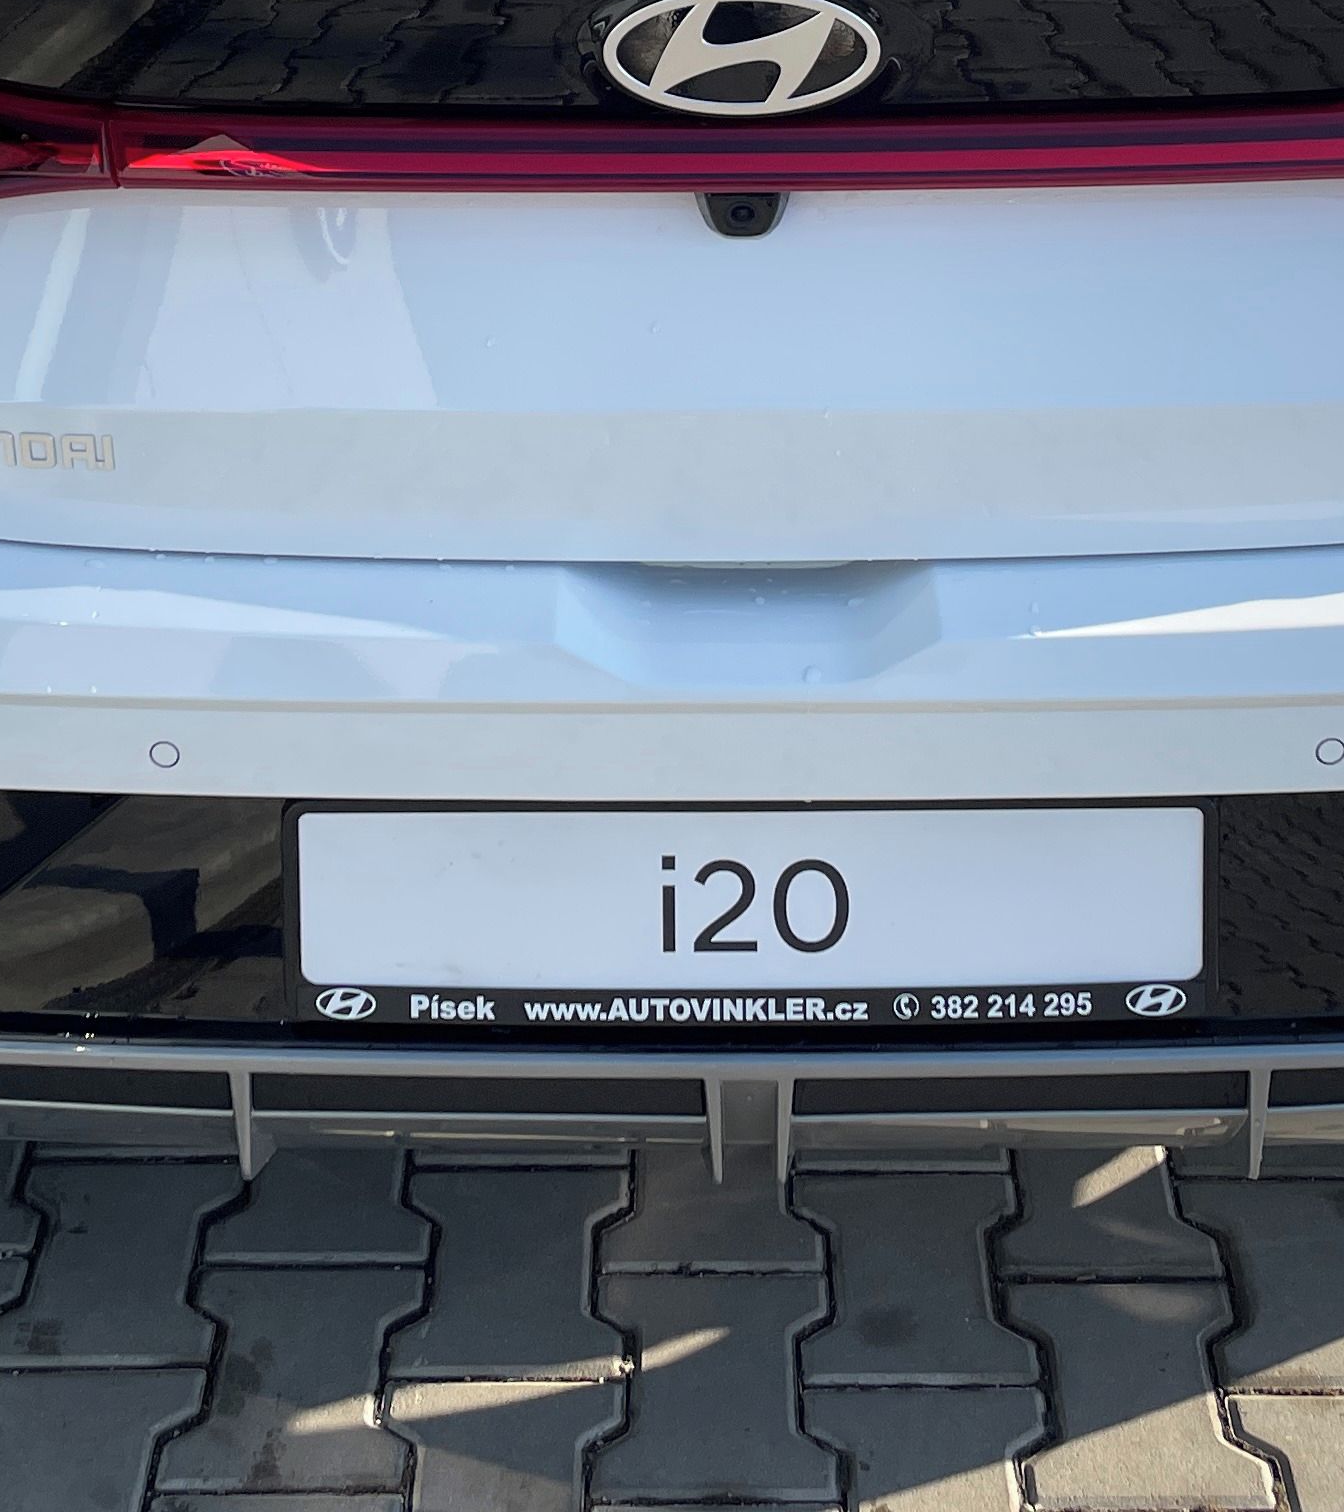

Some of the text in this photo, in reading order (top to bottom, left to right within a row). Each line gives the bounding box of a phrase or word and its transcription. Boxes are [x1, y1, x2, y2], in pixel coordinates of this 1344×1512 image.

[661, 855, 850, 953] i20
[410, 992, 1092, 1022] Písek www.AUTOVINKLER.cz 382 214 295
